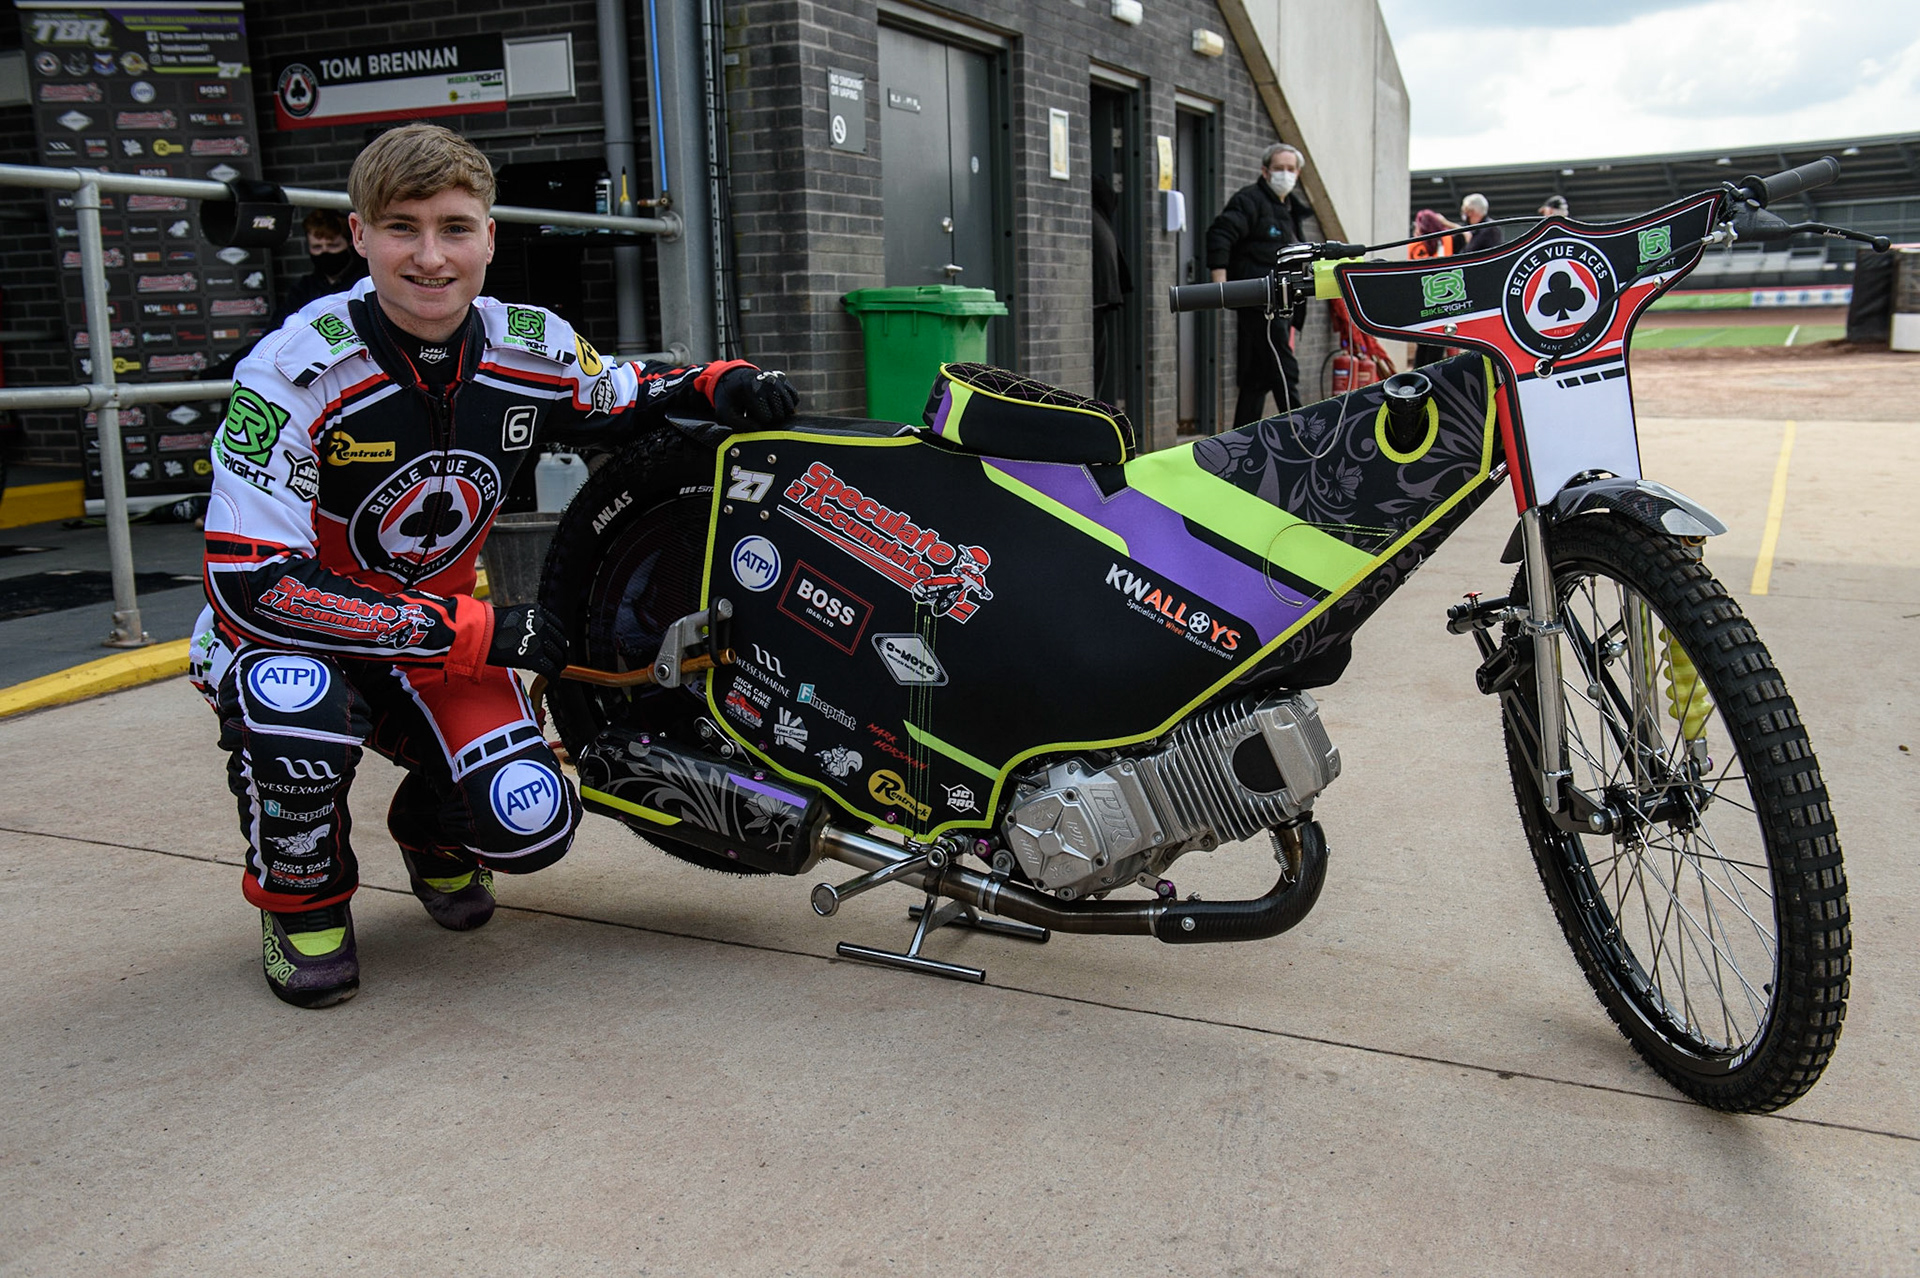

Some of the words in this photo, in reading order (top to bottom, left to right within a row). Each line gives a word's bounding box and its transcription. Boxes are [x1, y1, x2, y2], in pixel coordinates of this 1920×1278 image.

[320, 57, 362, 80] TOM
[368, 46, 458, 75] BRENNAN
[1510, 255, 1541, 296] BELLE
[1545, 245, 1574, 258] VUE
[1579, 250, 1608, 279] ACES
[1420, 300, 1474, 317] BIKERIGHT
[508, 412, 530, 443] 6
[327, 438, 393, 461] Rentruck
[290, 476, 319, 494] PRO
[299, 466, 317, 480] JC
[368, 467, 421, 515] BELLE
[430, 459, 467, 474] VUE
[470, 466, 496, 501] ACES
[592, 490, 633, 535] ANLAS
[802, 461, 956, 566] Speculate
[783, 480, 807, 504] 2
[801, 493, 934, 580] Accumulate
[738, 549, 773, 579] ATPI
[259, 588, 278, 607] 2
[272, 598, 392, 633] Accumulate
[273, 574, 398, 621] Speculate
[796, 578, 856, 627] BOSS
[822, 616, 835, 629] LTD
[1126, 599, 1156, 621] Specialist
[1156, 616, 1164, 625] in
[1165, 620, 1185, 637] Wheel
[1185, 631, 1234, 661] Refurbishment
[886, 641, 936, 676] C-MOTO
[260, 667, 316, 687] ATPI
[735, 675, 753, 691] MICK
[753, 688, 773, 704] CAVE
[736, 656, 791, 698] WESSEXMARINE
[732, 681, 752, 698] GRAB
[751, 694, 769, 710] HIRE
[800, 685, 857, 731] Fineprint
[866, 723, 898, 744] MARK
[873, 739, 931, 770] HORSMAN
[507, 777, 551, 816] ATPI
[873, 773, 929, 817] Rentruck
[947, 798, 975, 809] PRO
[952, 789, 971, 799] JC
[273, 860, 303, 870] MICK
